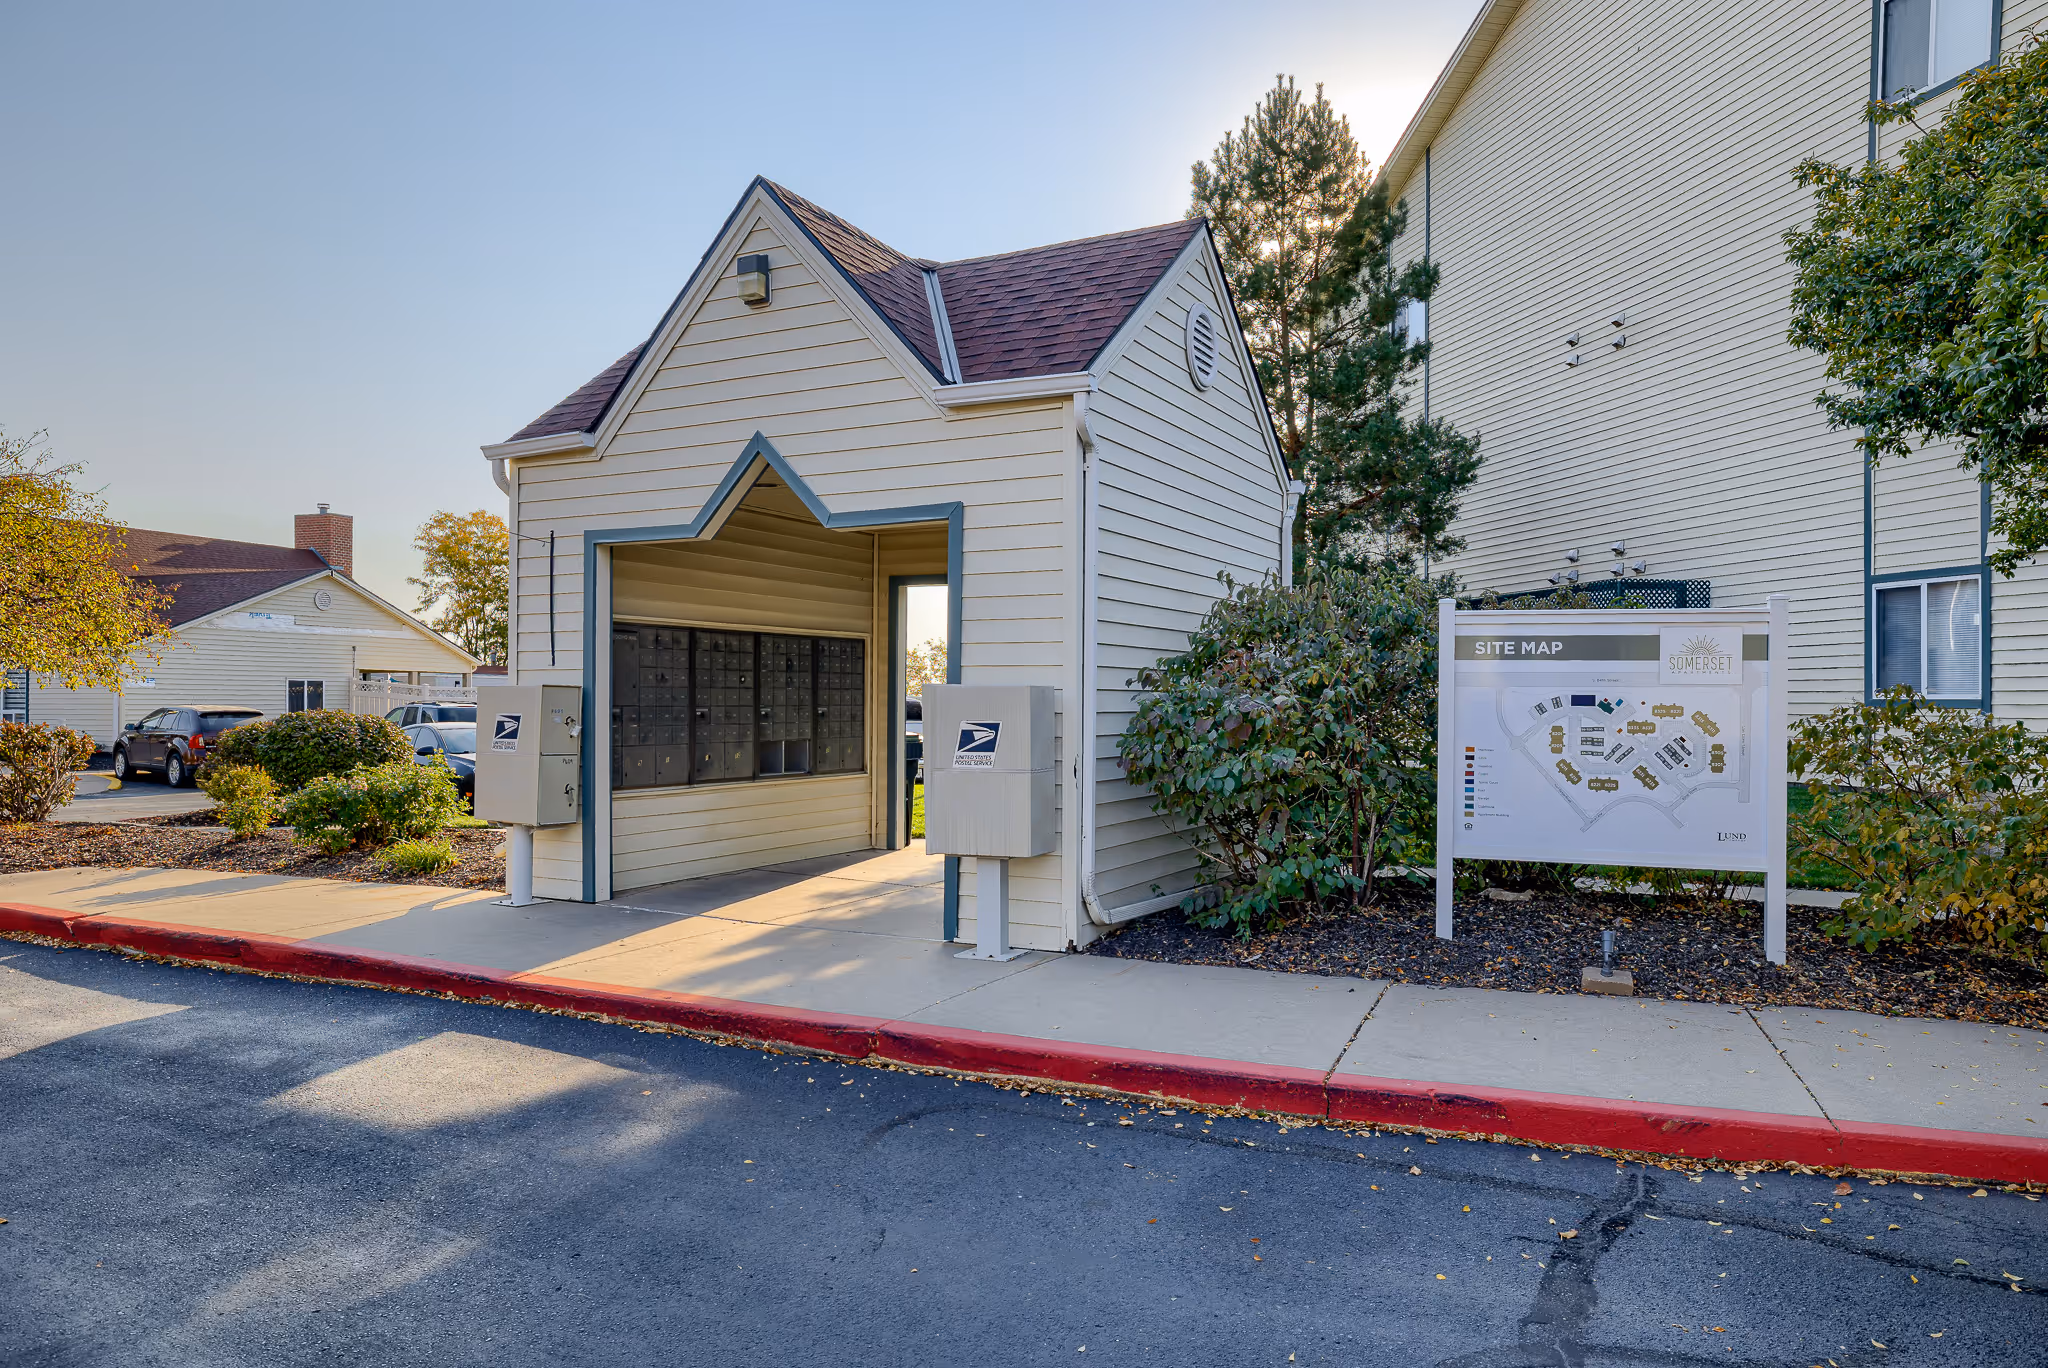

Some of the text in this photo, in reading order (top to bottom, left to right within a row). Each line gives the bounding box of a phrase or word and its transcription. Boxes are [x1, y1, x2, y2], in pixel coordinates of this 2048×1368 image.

[1475, 641, 1563, 655] SITE MAP
[1669, 656, 1733, 670] SOMERSET
[1717, 832, 1747, 842] LUND
